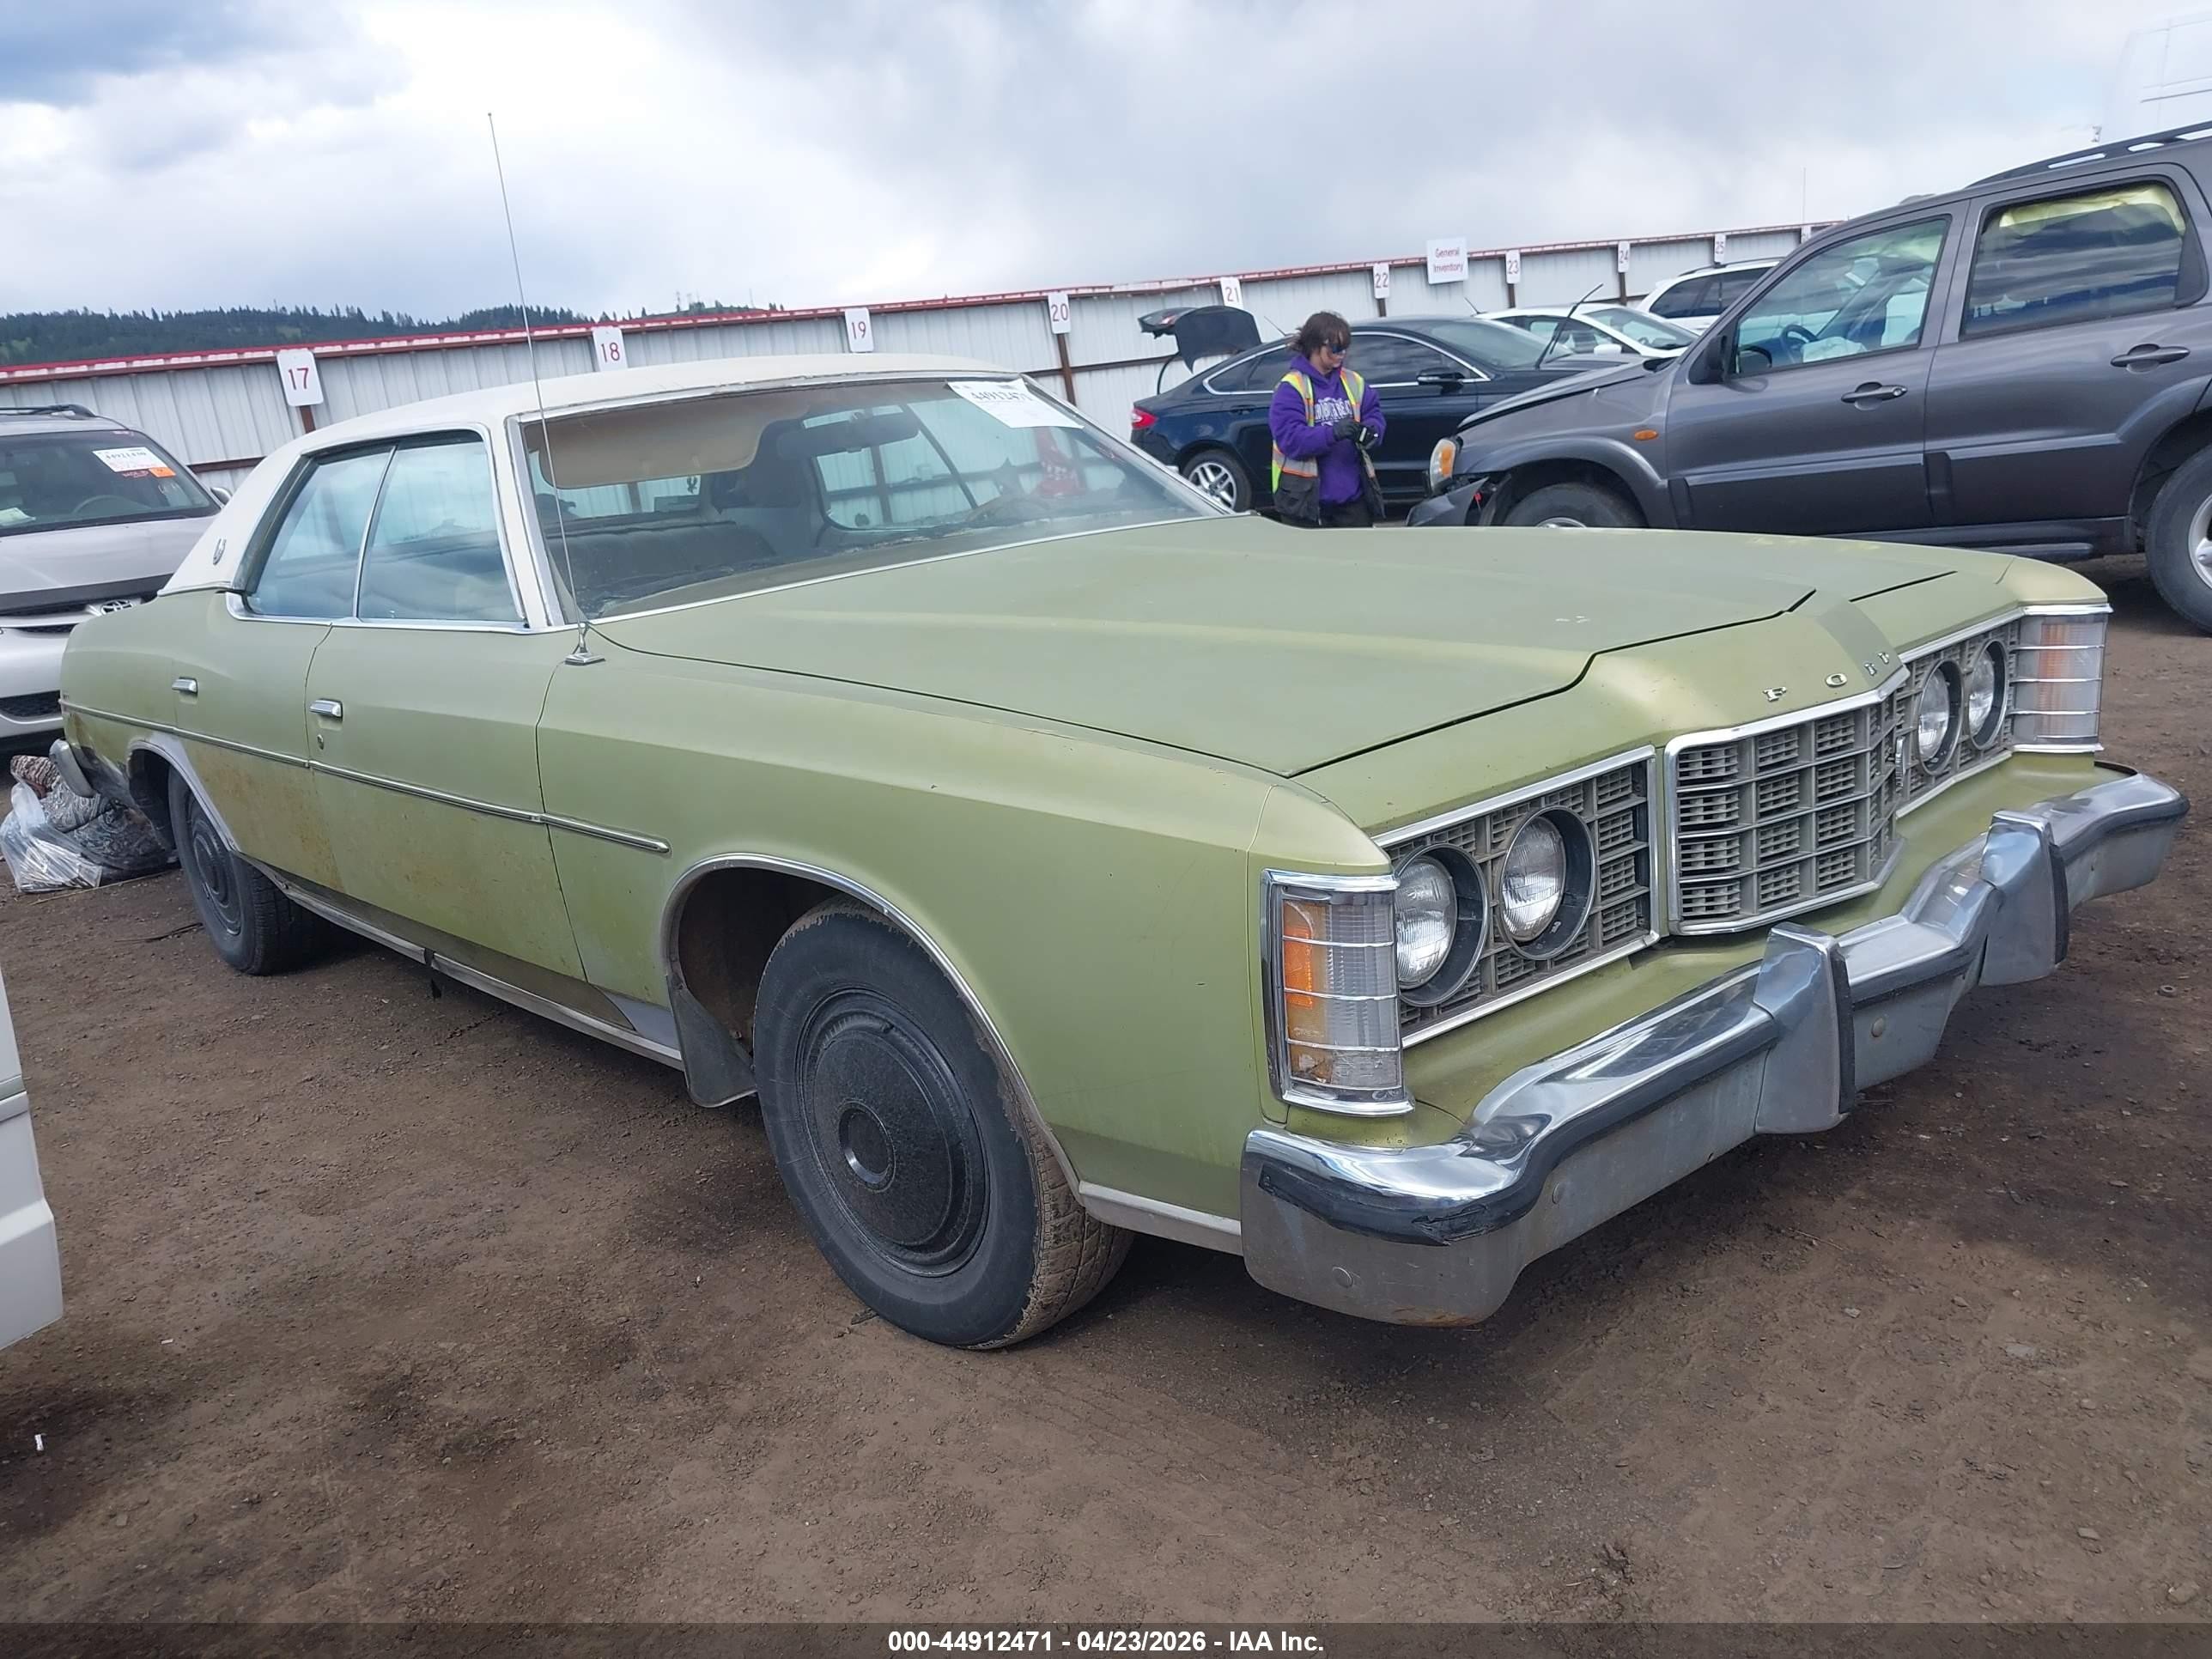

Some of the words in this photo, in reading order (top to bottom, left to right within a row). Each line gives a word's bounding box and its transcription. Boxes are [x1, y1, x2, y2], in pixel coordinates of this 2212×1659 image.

[1435, 247, 1460, 258] General
[1433, 262, 1464, 273] Inventory
[1508, 259, 1519, 275] 23
[1375, 272, 1389, 289] 22
[1224, 286, 1240, 302] 21
[1051, 303, 1068, 323] 20
[851, 321, 866, 340] 19
[601, 343, 621, 363] 18
[288, 368, 310, 391] 17
